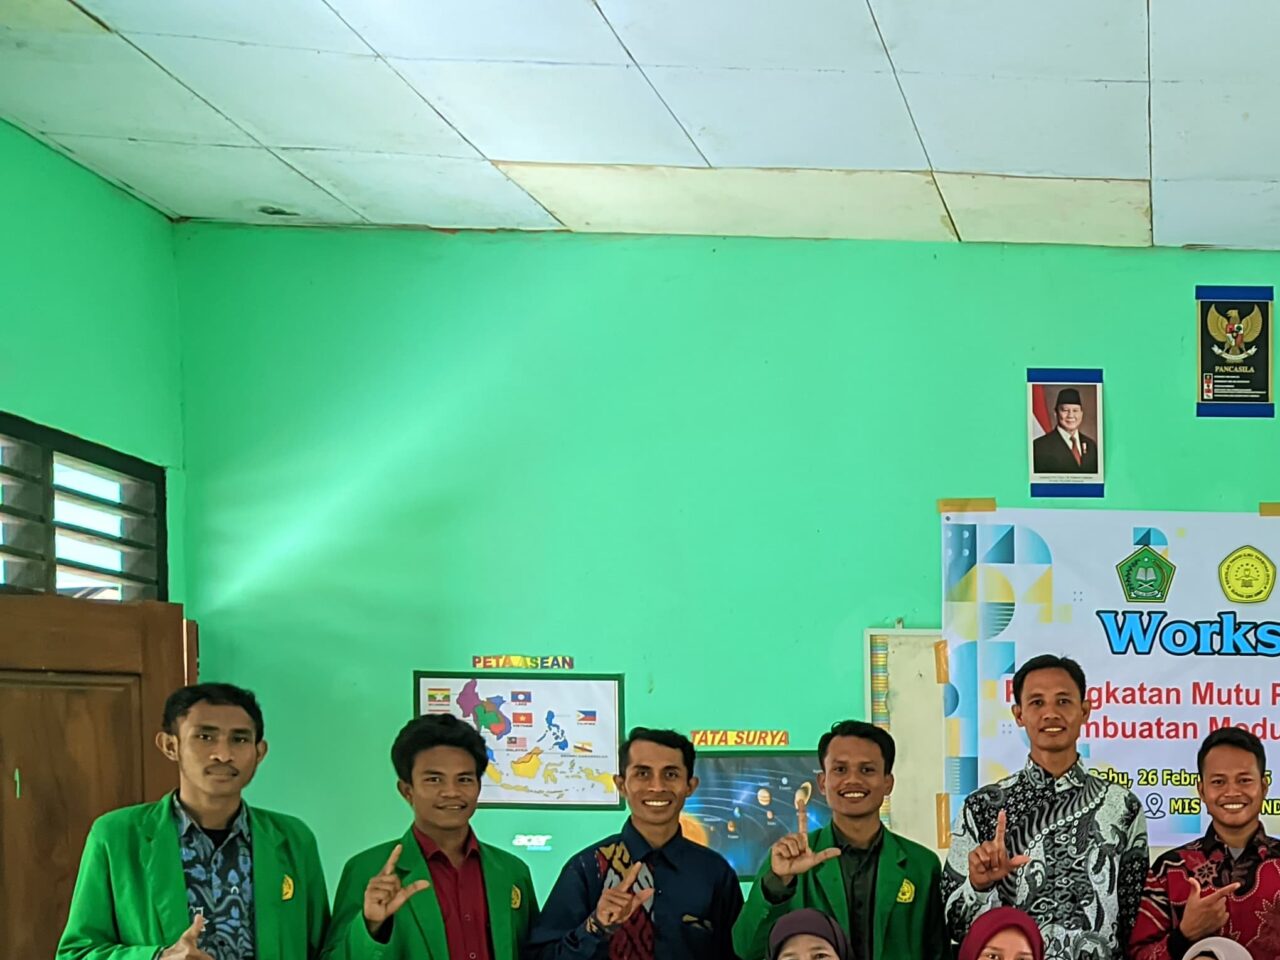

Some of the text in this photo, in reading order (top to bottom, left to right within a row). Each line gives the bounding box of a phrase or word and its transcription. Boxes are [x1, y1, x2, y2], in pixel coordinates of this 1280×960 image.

[1214, 365, 1255, 373] PANCASILA
[472, 656, 574, 669] PETA ASEAN
[1192, 682, 1261, 705] Mutu
[690, 730, 789, 746] TATA SURYA
[1137, 769, 1158, 786] 26
[1169, 797, 1201, 815] MIS
